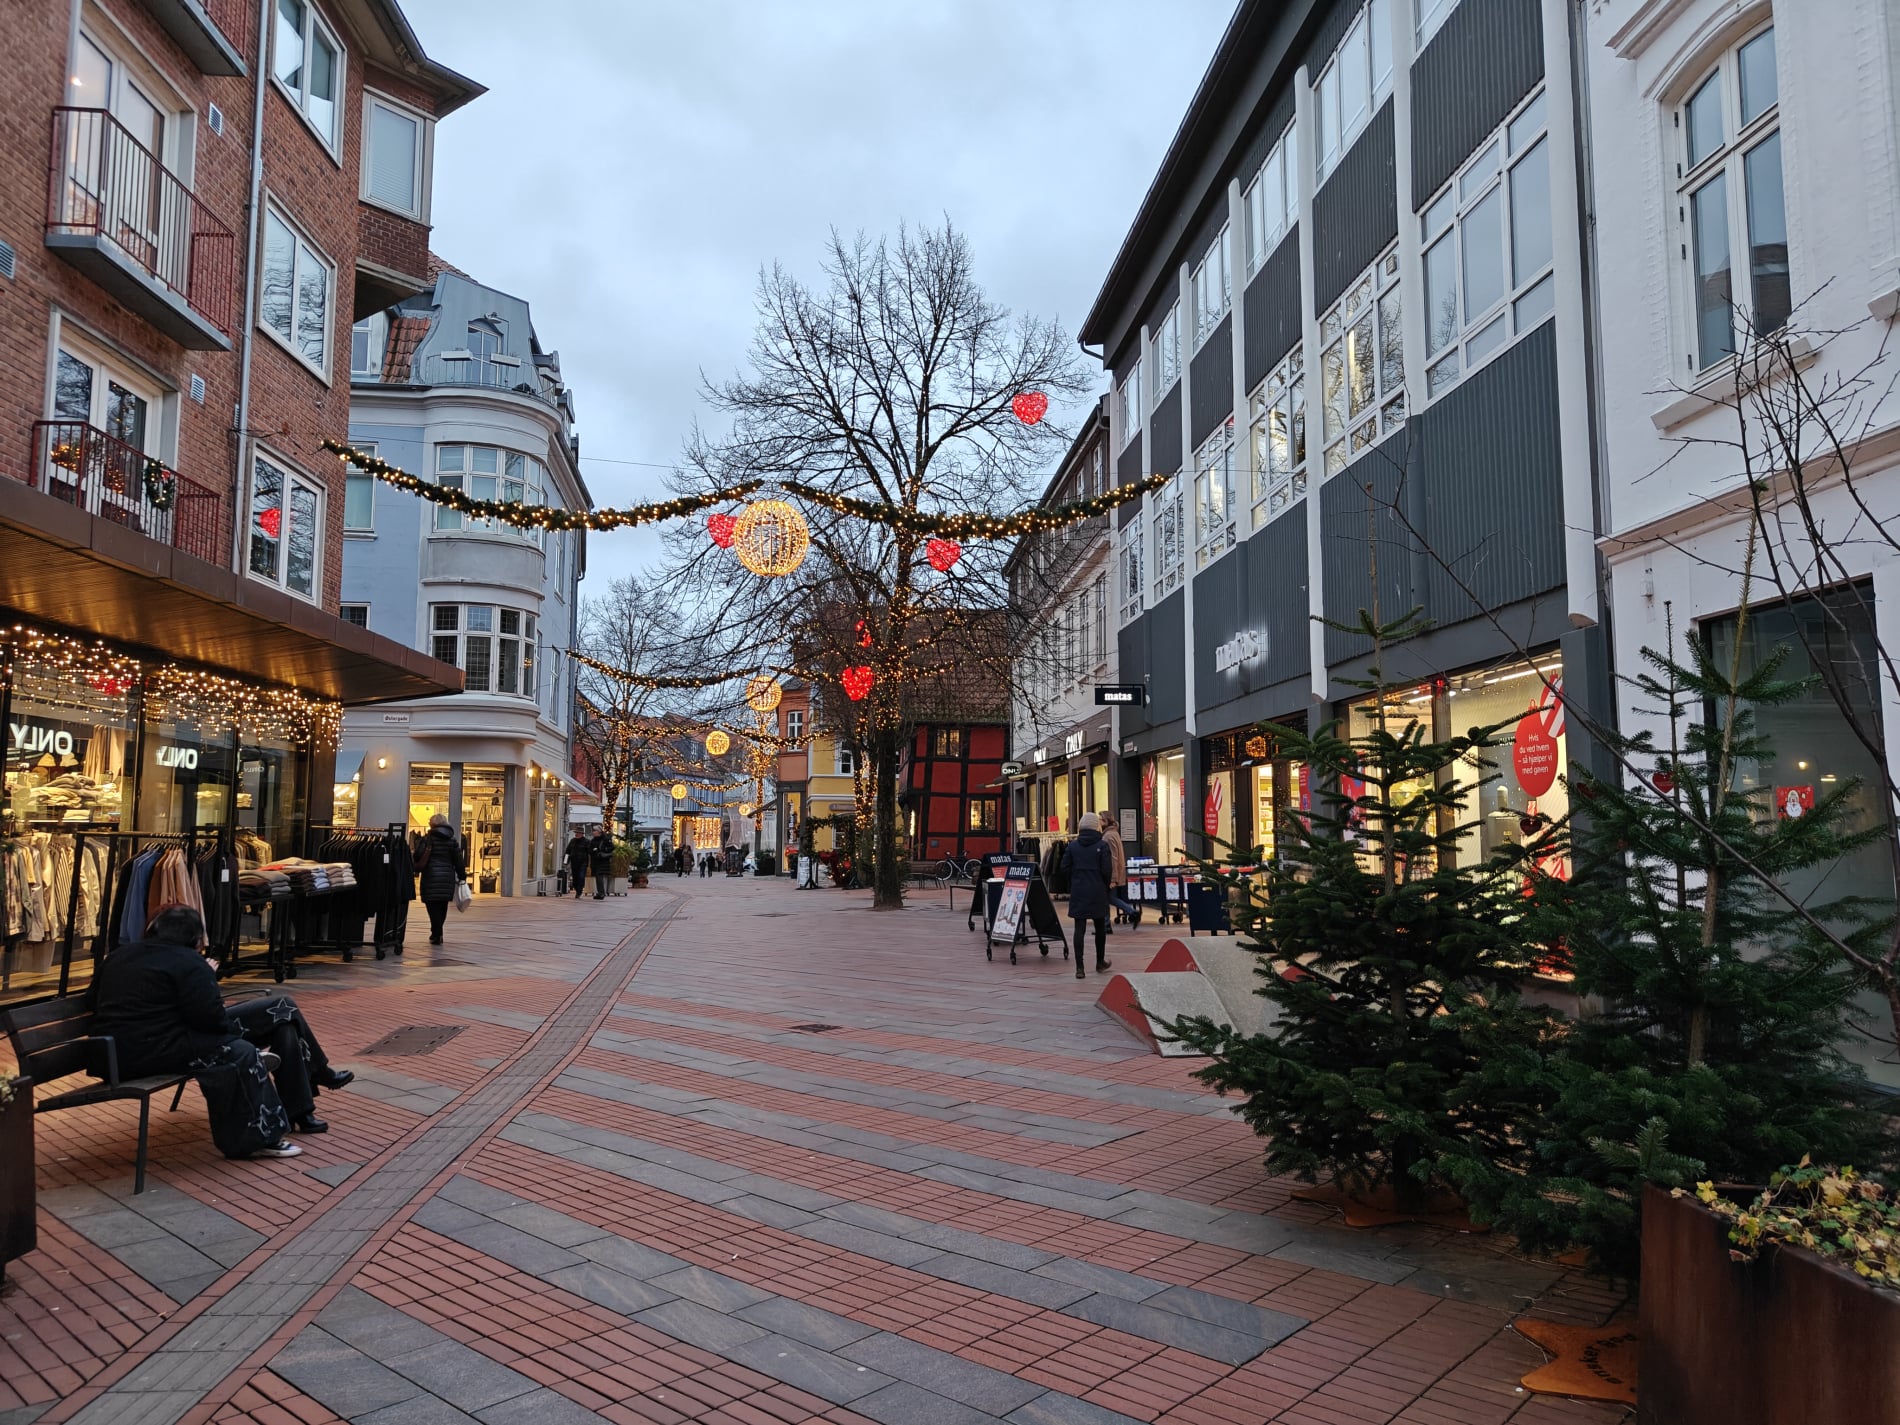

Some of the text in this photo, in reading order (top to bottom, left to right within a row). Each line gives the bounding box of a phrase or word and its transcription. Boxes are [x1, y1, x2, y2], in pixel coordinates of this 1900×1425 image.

[1104, 692, 1132, 702] matas
[1528, 733, 1539, 742] Hvis
[1066, 730, 1084, 759] ONLY
[1536, 744, 1549, 752] hvem
[1522, 755, 1528, 763] så
[1529, 754, 1547, 765] hjælper
[1522, 766, 1549, 775] med gaven
[990, 855, 1012, 863] matas
[1009, 866, 1031, 876] matas
